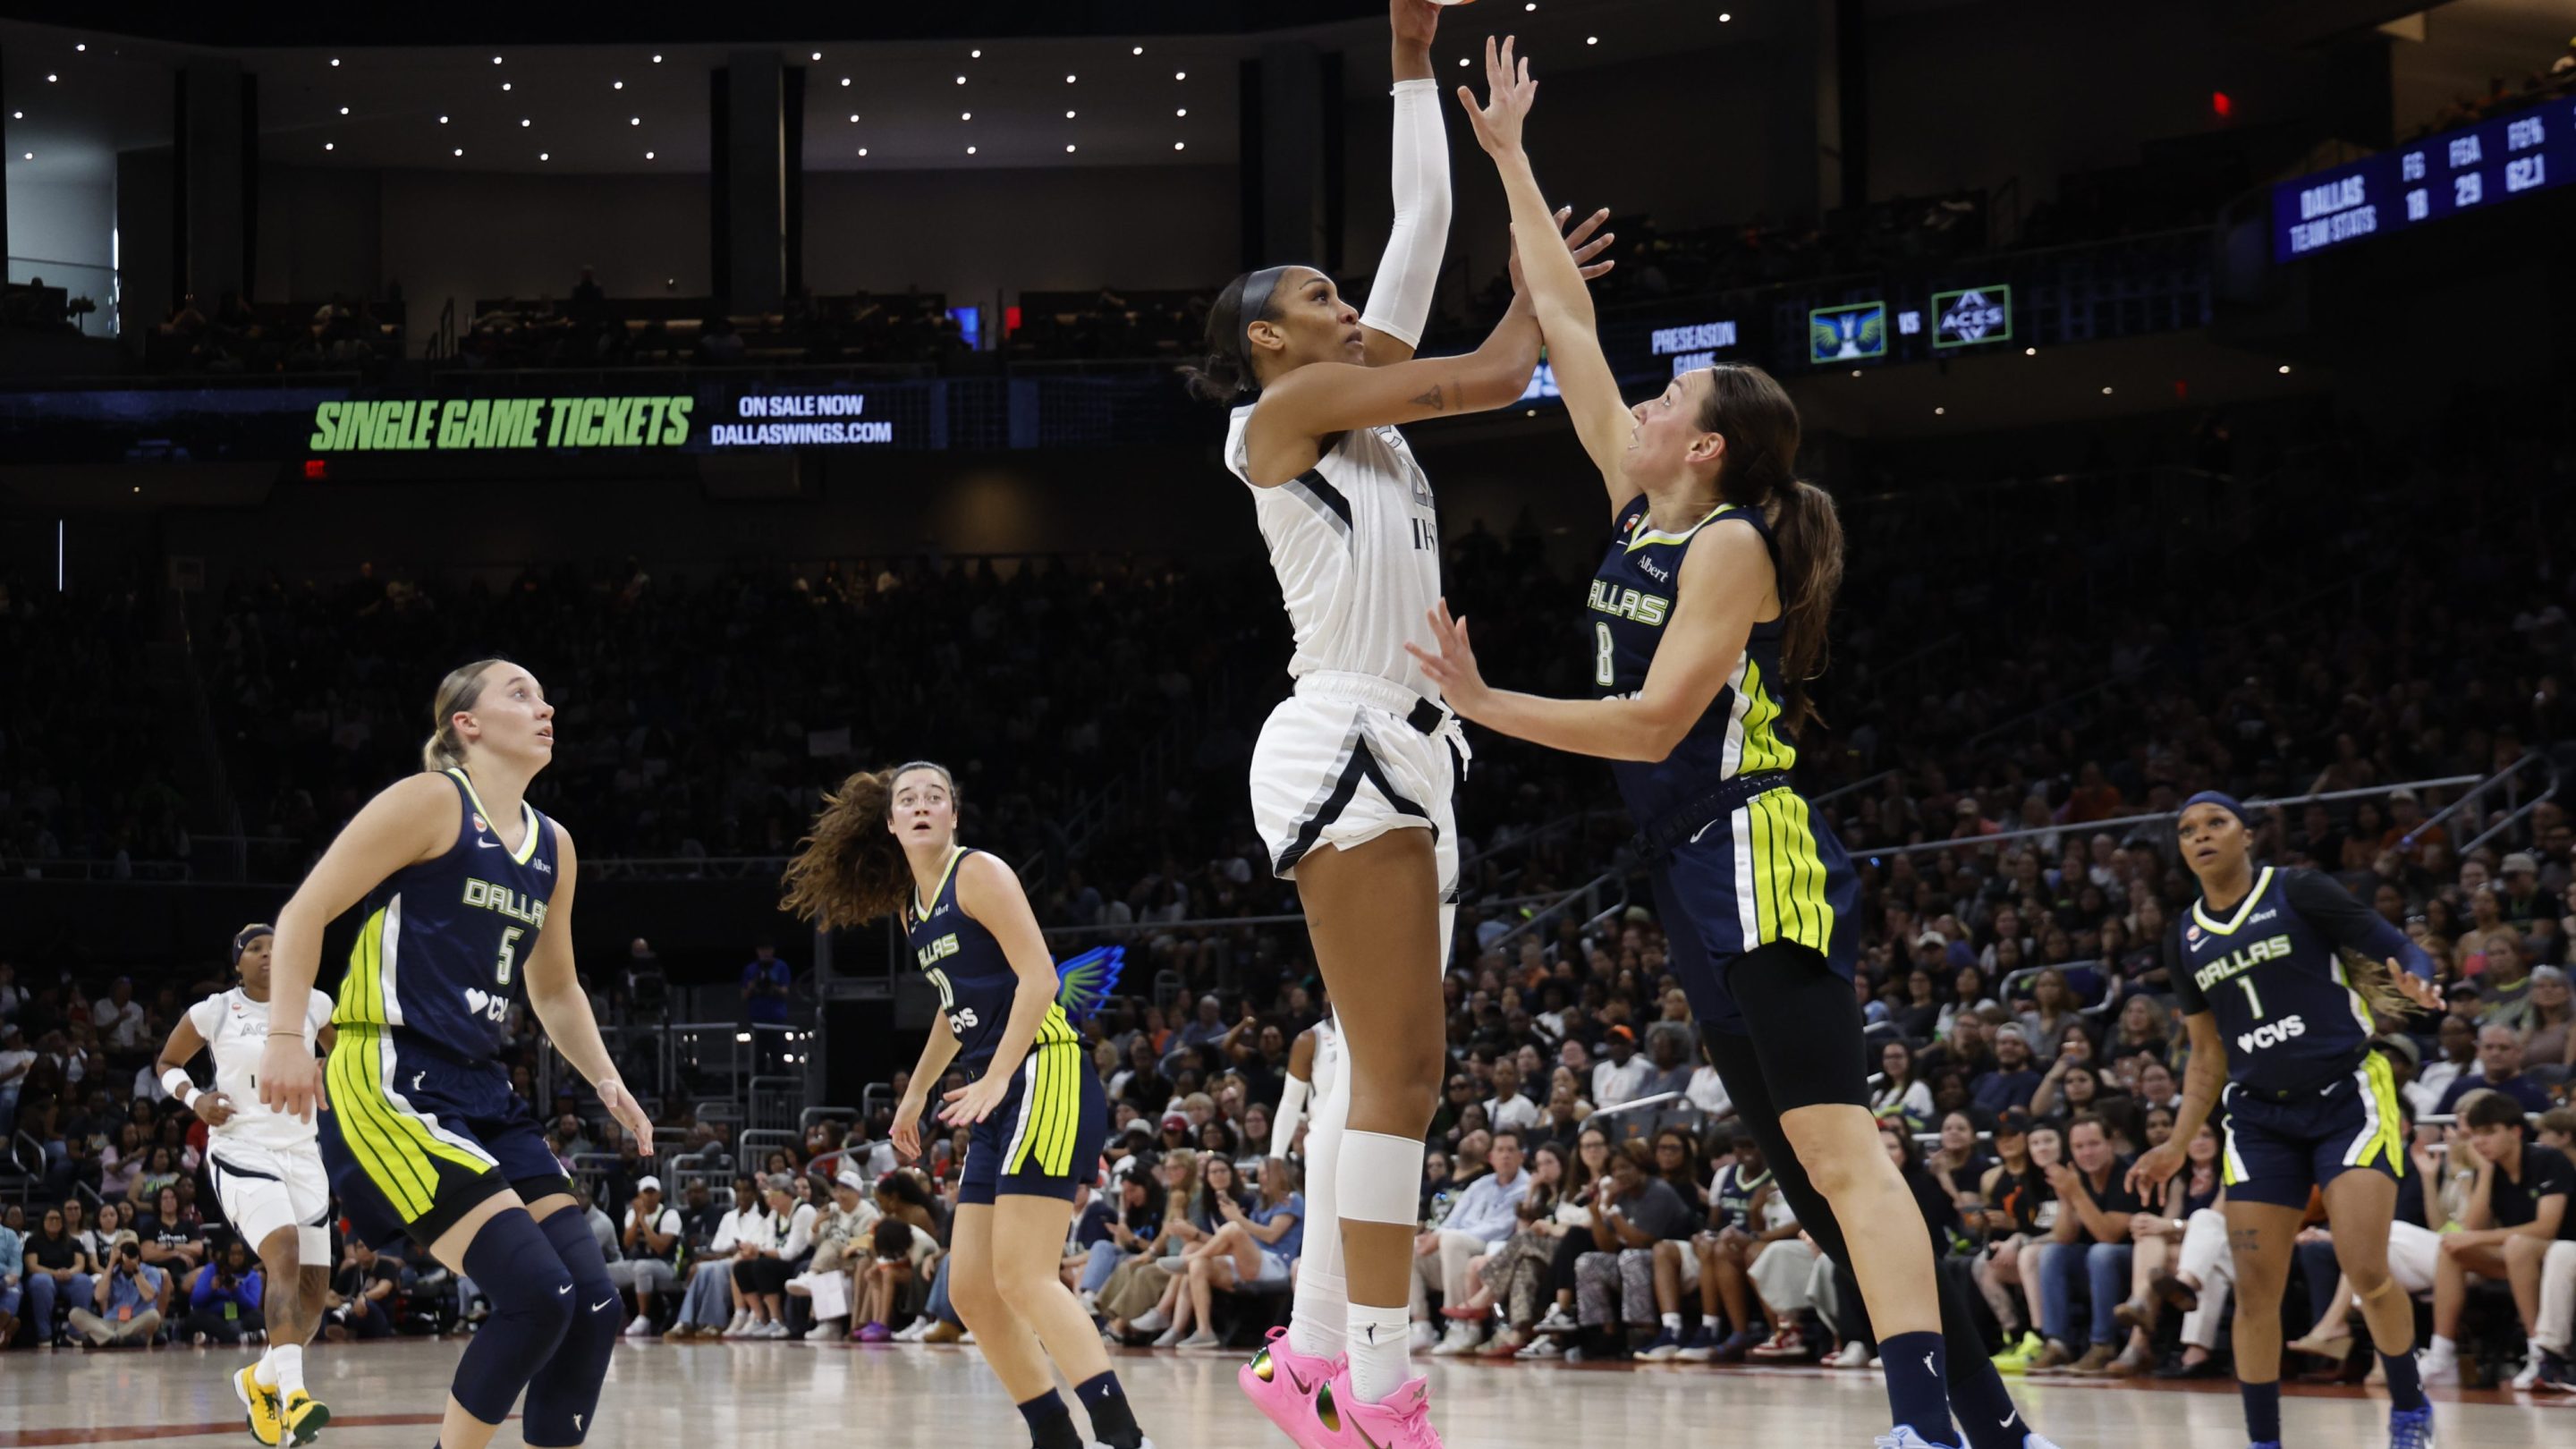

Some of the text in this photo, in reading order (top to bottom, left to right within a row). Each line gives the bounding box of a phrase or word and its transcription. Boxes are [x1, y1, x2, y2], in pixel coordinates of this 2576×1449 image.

[2300, 174, 2366, 221] DALLAS
[2289, 217, 2330, 253] TEAM
[1651, 319, 1737, 356] PRESEASON
[309, 395, 695, 451] SINGLE GAME TICKETS
[738, 394, 865, 418] ON SALE NOW
[710, 421, 893, 445] DALLASWINGS.COM
[1638, 554, 1670, 583] Albert
[1587, 579, 1670, 627] ALLAS
[1596, 621, 1614, 687] 8
[496, 925, 525, 986] 5
[2193, 933, 2292, 993] DALLAS
[2235, 973, 2265, 1021] 1
[2252, 1013, 2307, 1049] CVS
